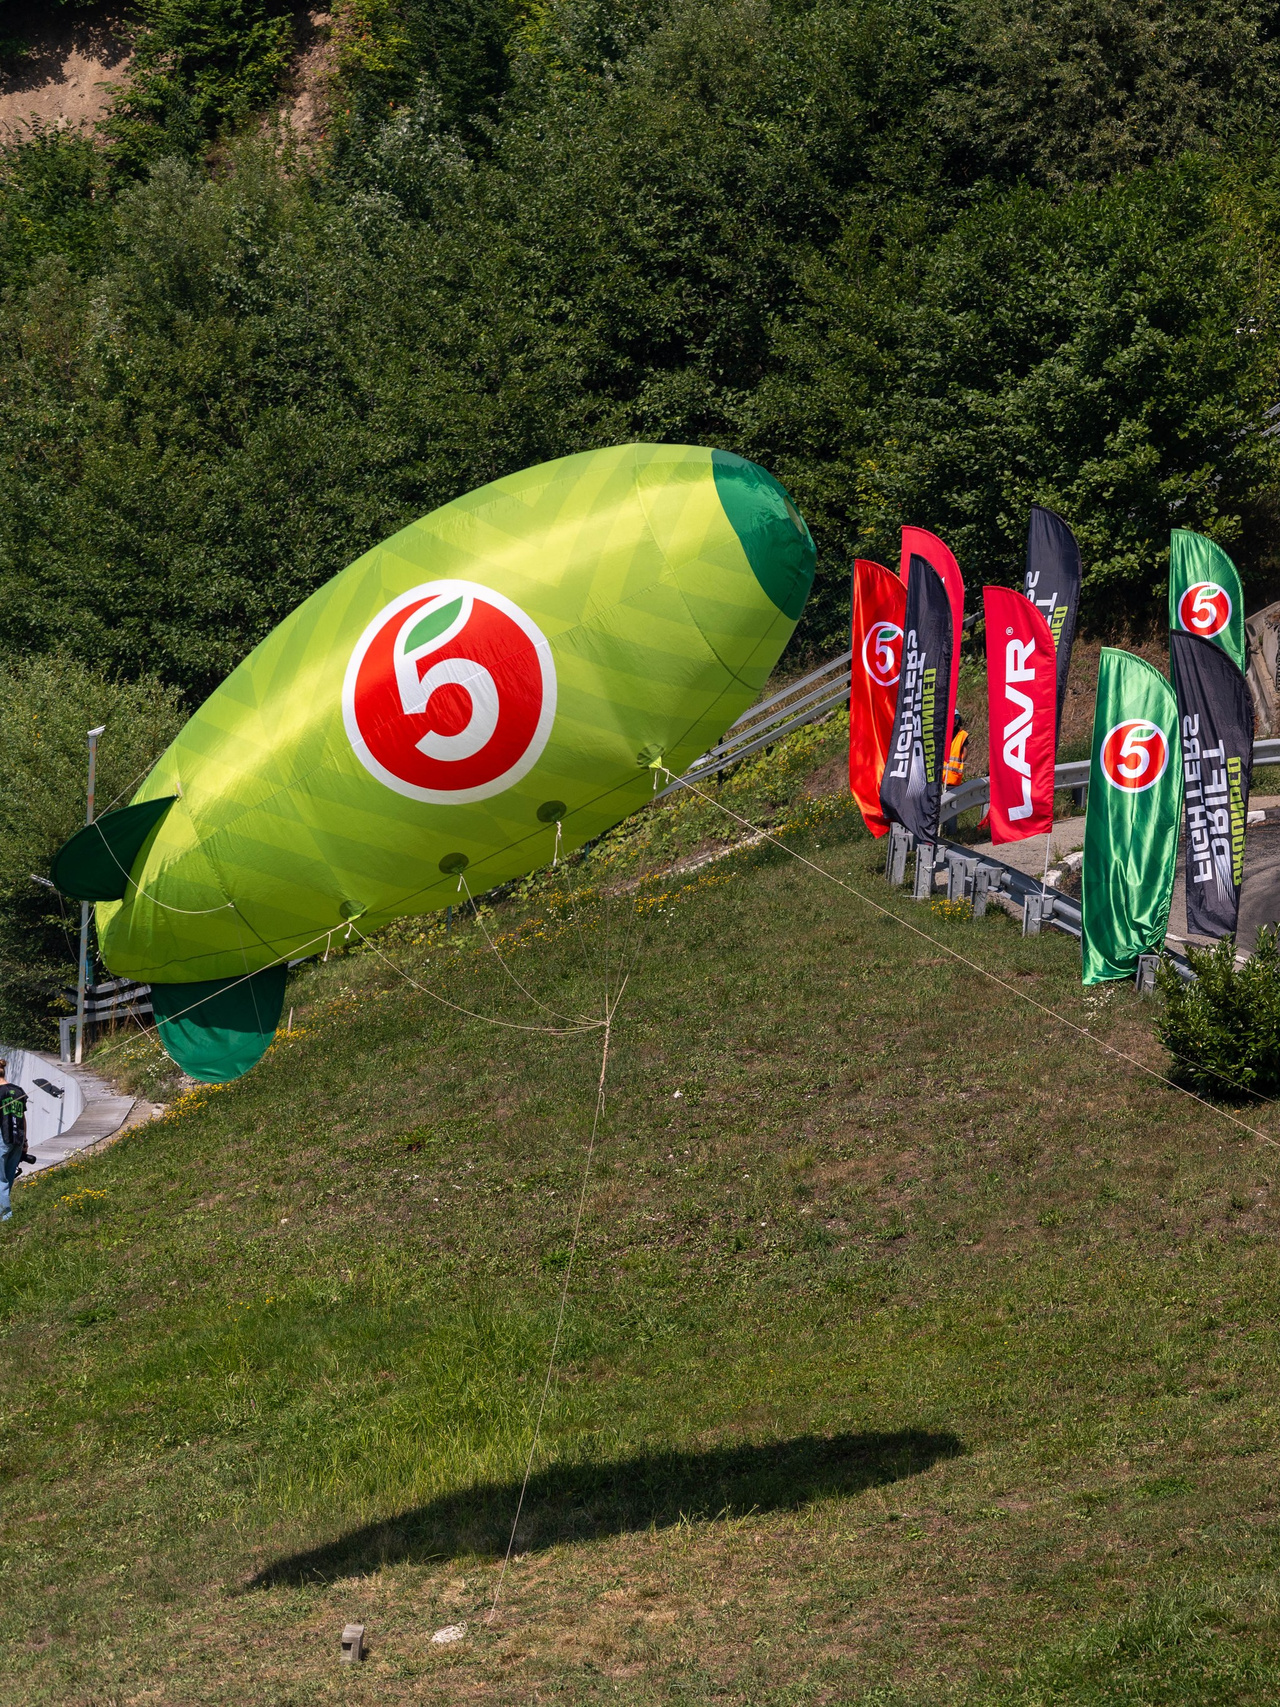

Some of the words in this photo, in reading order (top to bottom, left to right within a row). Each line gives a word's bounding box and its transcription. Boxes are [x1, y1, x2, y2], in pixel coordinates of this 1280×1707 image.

[1191, 586, 1222, 629] 5
[393, 591, 500, 762] 5
[875, 627, 899, 674] 5
[1003, 636, 1036, 822] LAVR
[1117, 725, 1158, 779] 5
